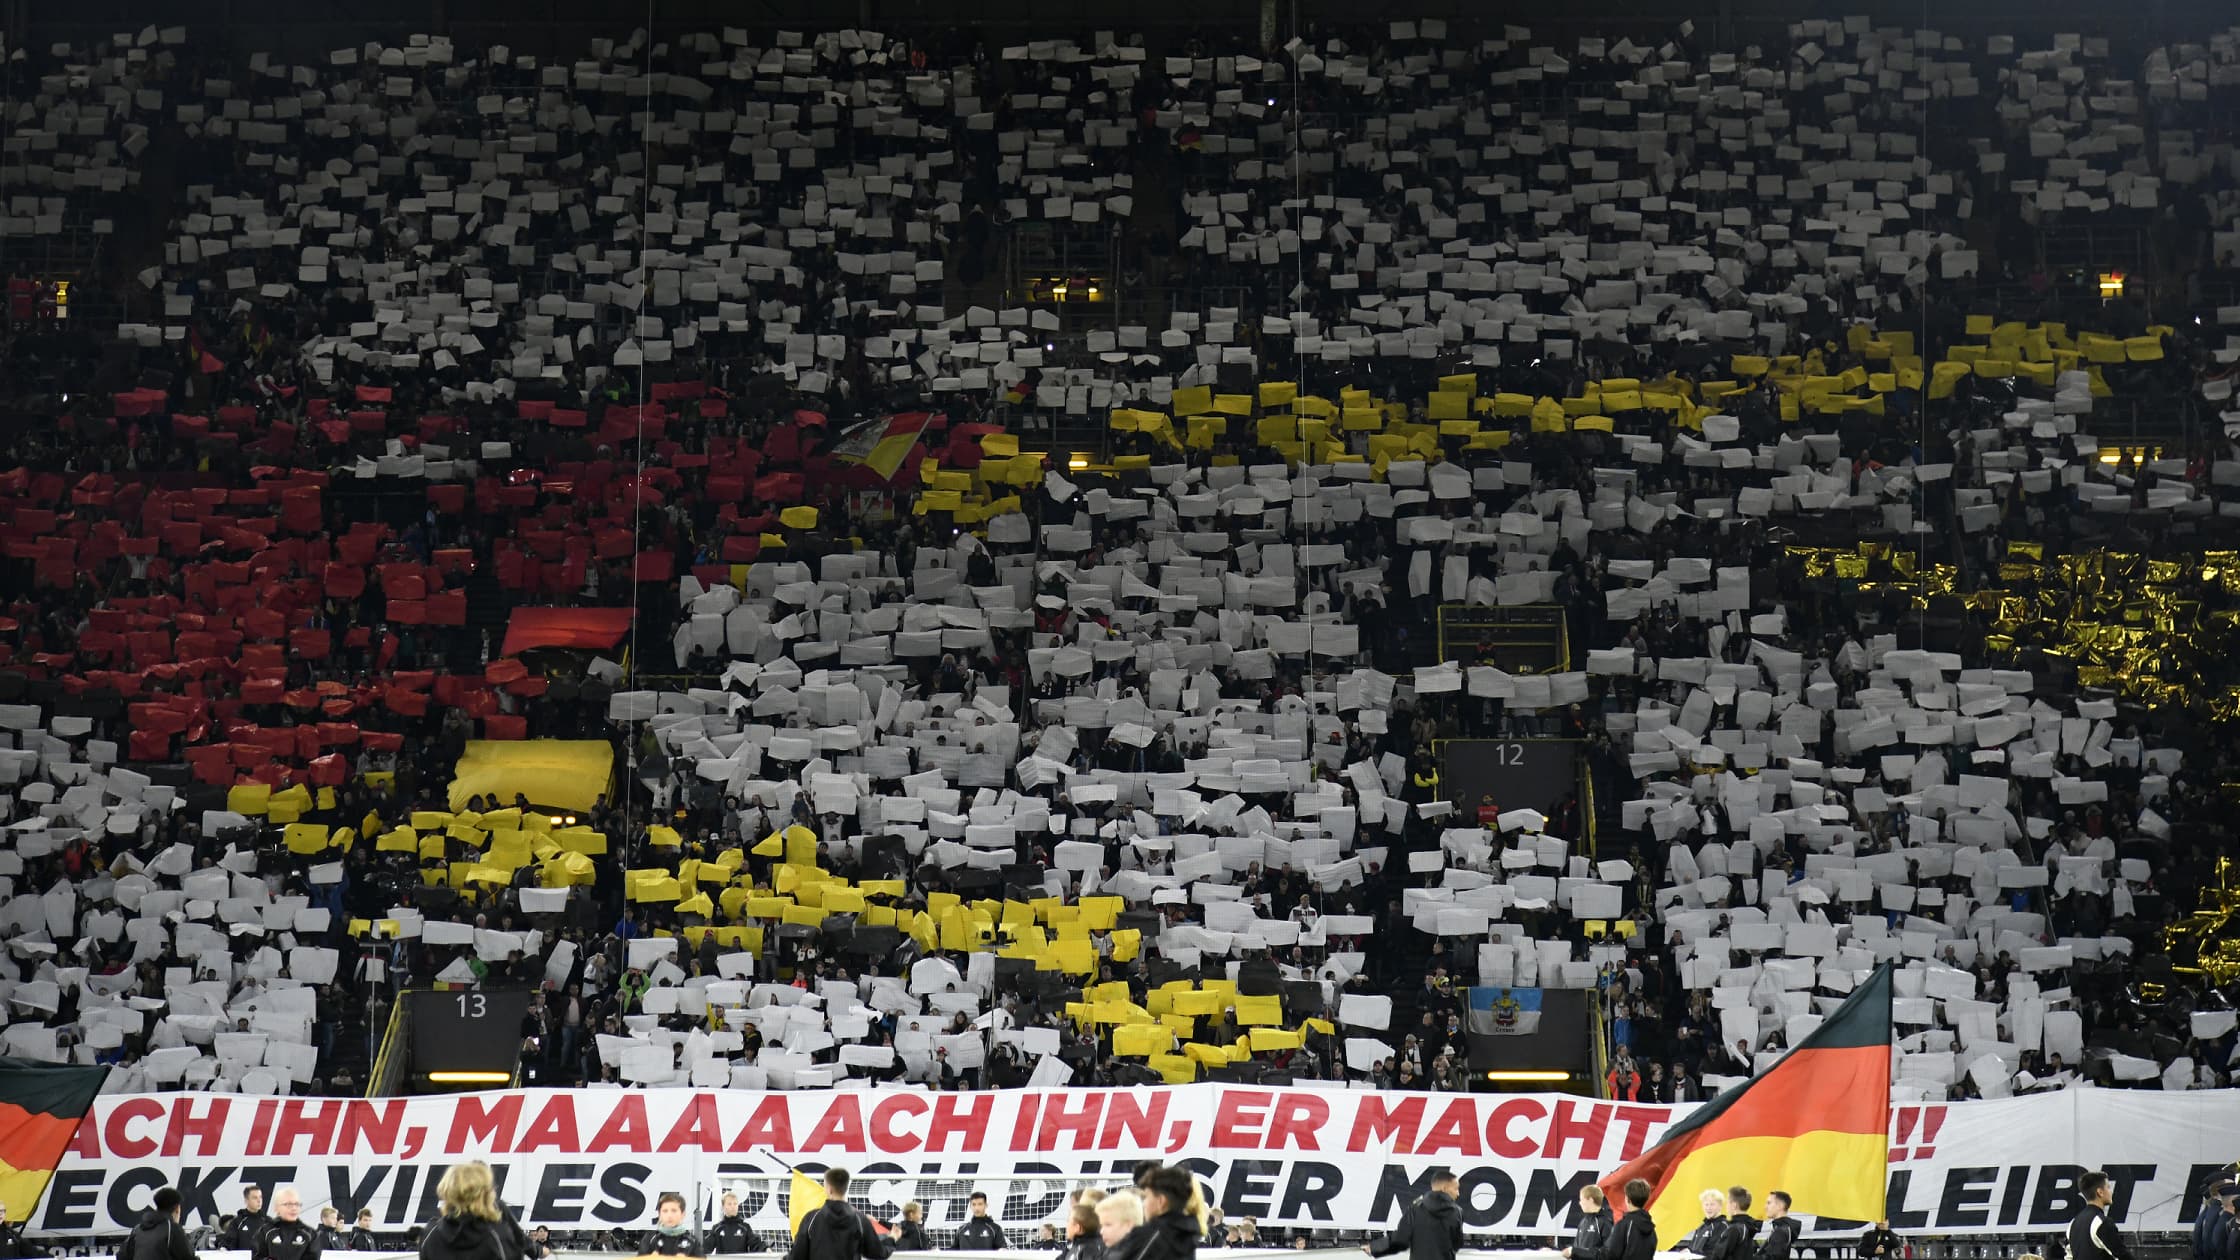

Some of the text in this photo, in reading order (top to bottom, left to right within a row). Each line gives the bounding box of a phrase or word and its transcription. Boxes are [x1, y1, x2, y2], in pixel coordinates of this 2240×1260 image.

[1495, 743, 1524, 766] 12
[456, 994, 486, 1018] 13
[244, 1098, 429, 1161] IHN,
[444, 1093, 995, 1154] MAAAAACH
[1010, 1090, 1193, 1154] IHN,
[1209, 1088, 1330, 1151] ER
[1346, 1096, 1672, 1162] MACHT
[327, 1163, 680, 1226] VILES
[1001, 1156, 1344, 1224] DSER
[1813, 1163, 2158, 1231] LEIBT
